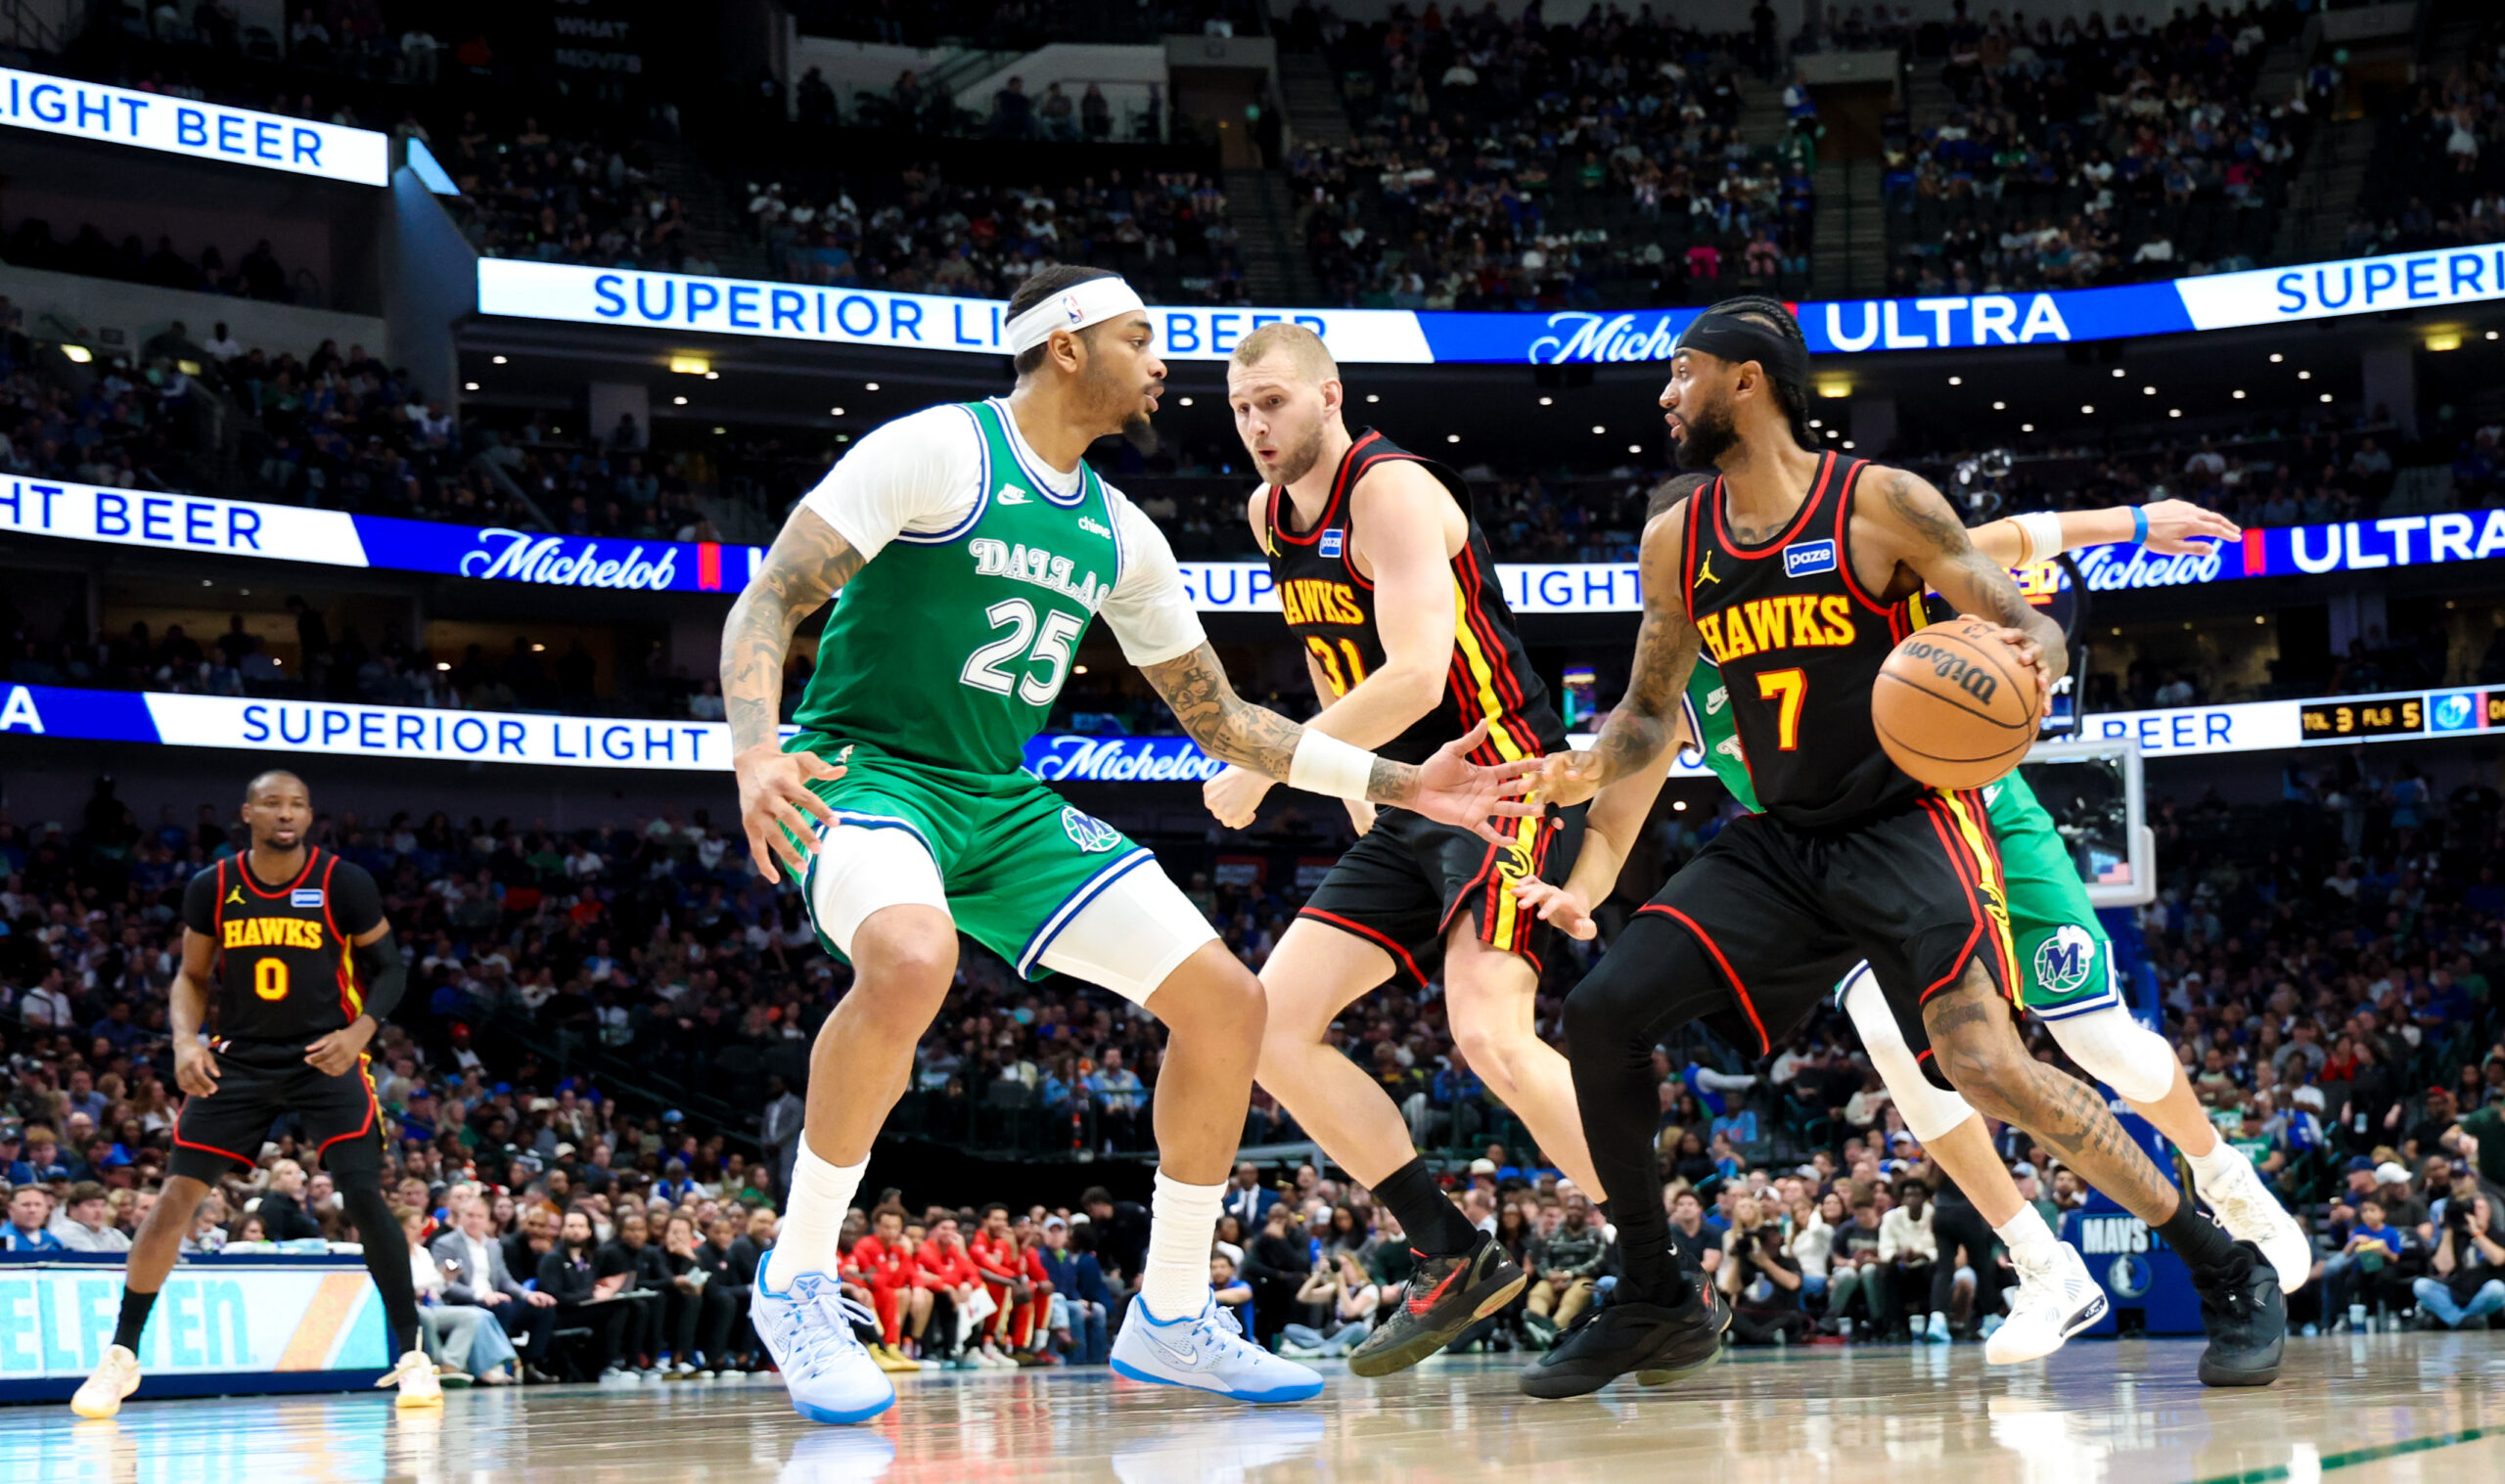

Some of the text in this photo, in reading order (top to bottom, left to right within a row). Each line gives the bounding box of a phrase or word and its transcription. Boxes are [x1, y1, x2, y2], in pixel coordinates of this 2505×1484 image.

[0, 78, 323, 166] IGHT BEER
[594, 274, 922, 341] SUPERIOR
[1826, 293, 2072, 352] ULTRA
[96, 492, 261, 550] BEER
[459, 527, 678, 591] Michelob
[1077, 516, 1113, 540] chime
[1789, 548, 1832, 569] paze
[1507, 570, 1641, 607] IGHT
[959, 597, 1085, 706] 25
[1695, 593, 1857, 664] HAWKS
[1305, 635, 1369, 698] 31
[1901, 641, 1998, 707] Wilson
[242, 704, 526, 755] SUPERIOR
[553, 723, 709, 762] LIGHT
[1754, 666, 1808, 751] 7
[2335, 706, 2354, 733] 3
[2402, 701, 2421, 729] 5
[222, 917, 324, 950] HAWKS
[253, 956, 291, 1003] 0
[2081, 1217, 2150, 1255] MAVS
